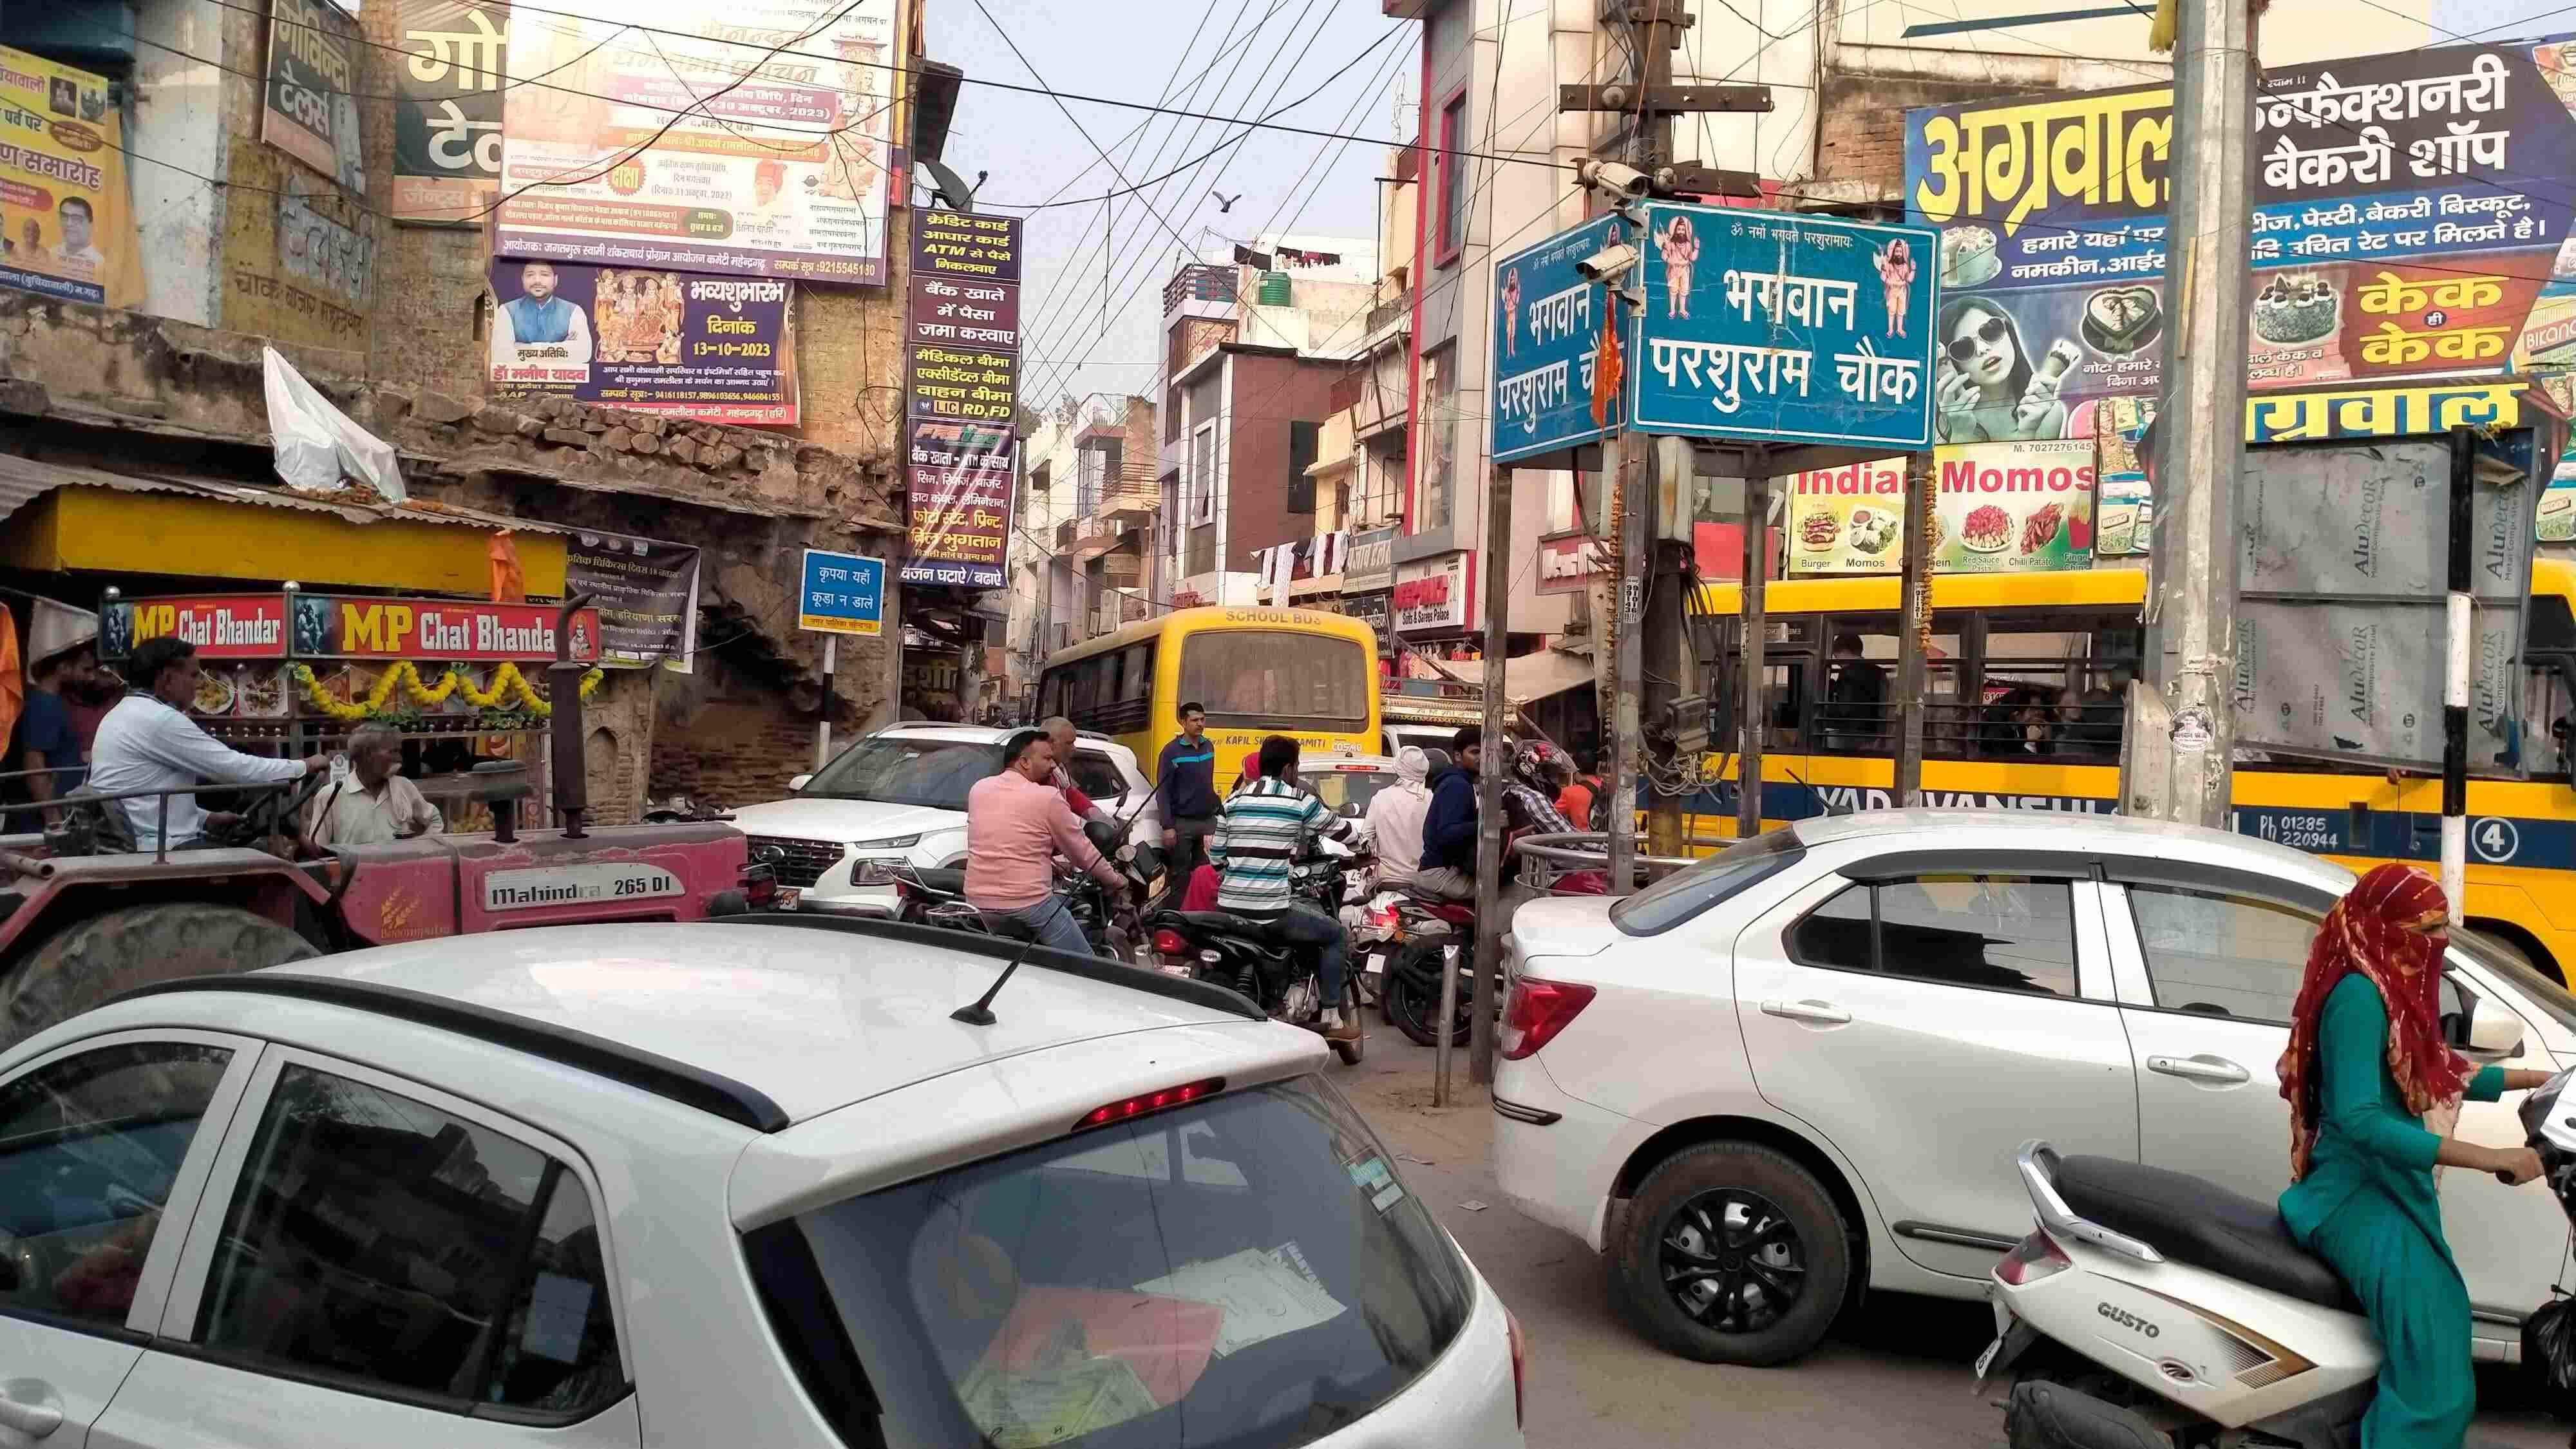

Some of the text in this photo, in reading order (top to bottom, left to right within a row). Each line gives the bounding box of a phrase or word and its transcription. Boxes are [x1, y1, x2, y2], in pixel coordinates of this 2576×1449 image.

[406, 9, 507, 90] गो
[2262, 120, 2510, 191] बैकरी शॉप
[21, 146, 103, 191] समारोह
[926, 213, 1010, 232] क्रेडिट कार्ड
[922, 231, 1010, 247] आधार कार्ड
[1772, 226, 1799, 243] भगवते
[2021, 233, 2081, 255] हमारे
[2134, 226, 2167, 243] पर
[2287, 218, 2507, 258] उचित रेट पर मिलते
[583, 243, 605, 257] स्वामी
[607, 245, 645, 260] शंकराचार्य
[646, 247, 670, 261] प्रोग्राम
[672, 250, 705, 264] आयोजन
[707, 252, 730, 267] कमेटी
[923, 243, 984, 258] ATM से
[774, 258, 800, 272] सम्पर्क
[691, 278, 785, 312] भव्यशुभारंभ
[963, 287, 1006, 301] खाते
[1723, 269, 1858, 331] भगवान
[2356, 270, 2510, 314] केक
[937, 303, 957, 318] में
[1529, 284, 1591, 345] भगवान
[2427, 313, 2443, 326] ही
[707, 314, 757, 334] दिनांक
[917, 323, 1016, 345] जमा करवाए
[2358, 321, 2512, 365] केक
[517, 348, 538, 361] मुख्य
[693, 341, 771, 357] 13-10-2023
[2277, 347, 2308, 361] केक
[494, 364, 587, 381] डॉ मनीष यादव
[734, 367, 753, 377] सहित
[2117, 357, 2154, 373] हमारे
[614, 375, 624, 384] श्री
[981, 370, 1010, 386] बीमा
[1649, 335, 1921, 414] परशुराम चौक
[600, 387, 628, 398] सम्पर्क
[916, 384, 1013, 403] वाहन बीमा
[1498, 359, 1570, 433] परशुराम
[936, 402, 1010, 418] LIC RD,FD
[930, 451, 952, 466] खाता
[1797, 460, 2093, 495] India Momos
[943, 533, 1002, 552] भुगतान
[1801, 558, 1832, 570] Burger
[1846, 558, 1886, 567] Momos
[2009, 557, 2028, 566] Chilli
[819, 567, 871, 585] कृपया यहाँ
[840, 594, 848, 607] न
[1226, 611, 1321, 625] SCHOOL BUS
[1434, 607, 1450, 621] Palace
[132, 605, 281, 650] MP Chat Bhandar
[341, 603, 556, 652] MP Chat Bhanda
[1226, 735, 1251, 746] KAPIL
[2259, 815, 2327, 840] Ph 01285
[2282, 833, 2339, 850] 220944
[2482, 824, 2505, 853] 4
[614, 877, 646, 896] 265
[652, 876, 671, 893] DI
[2096, 1301, 2161, 1339] GUSTO
